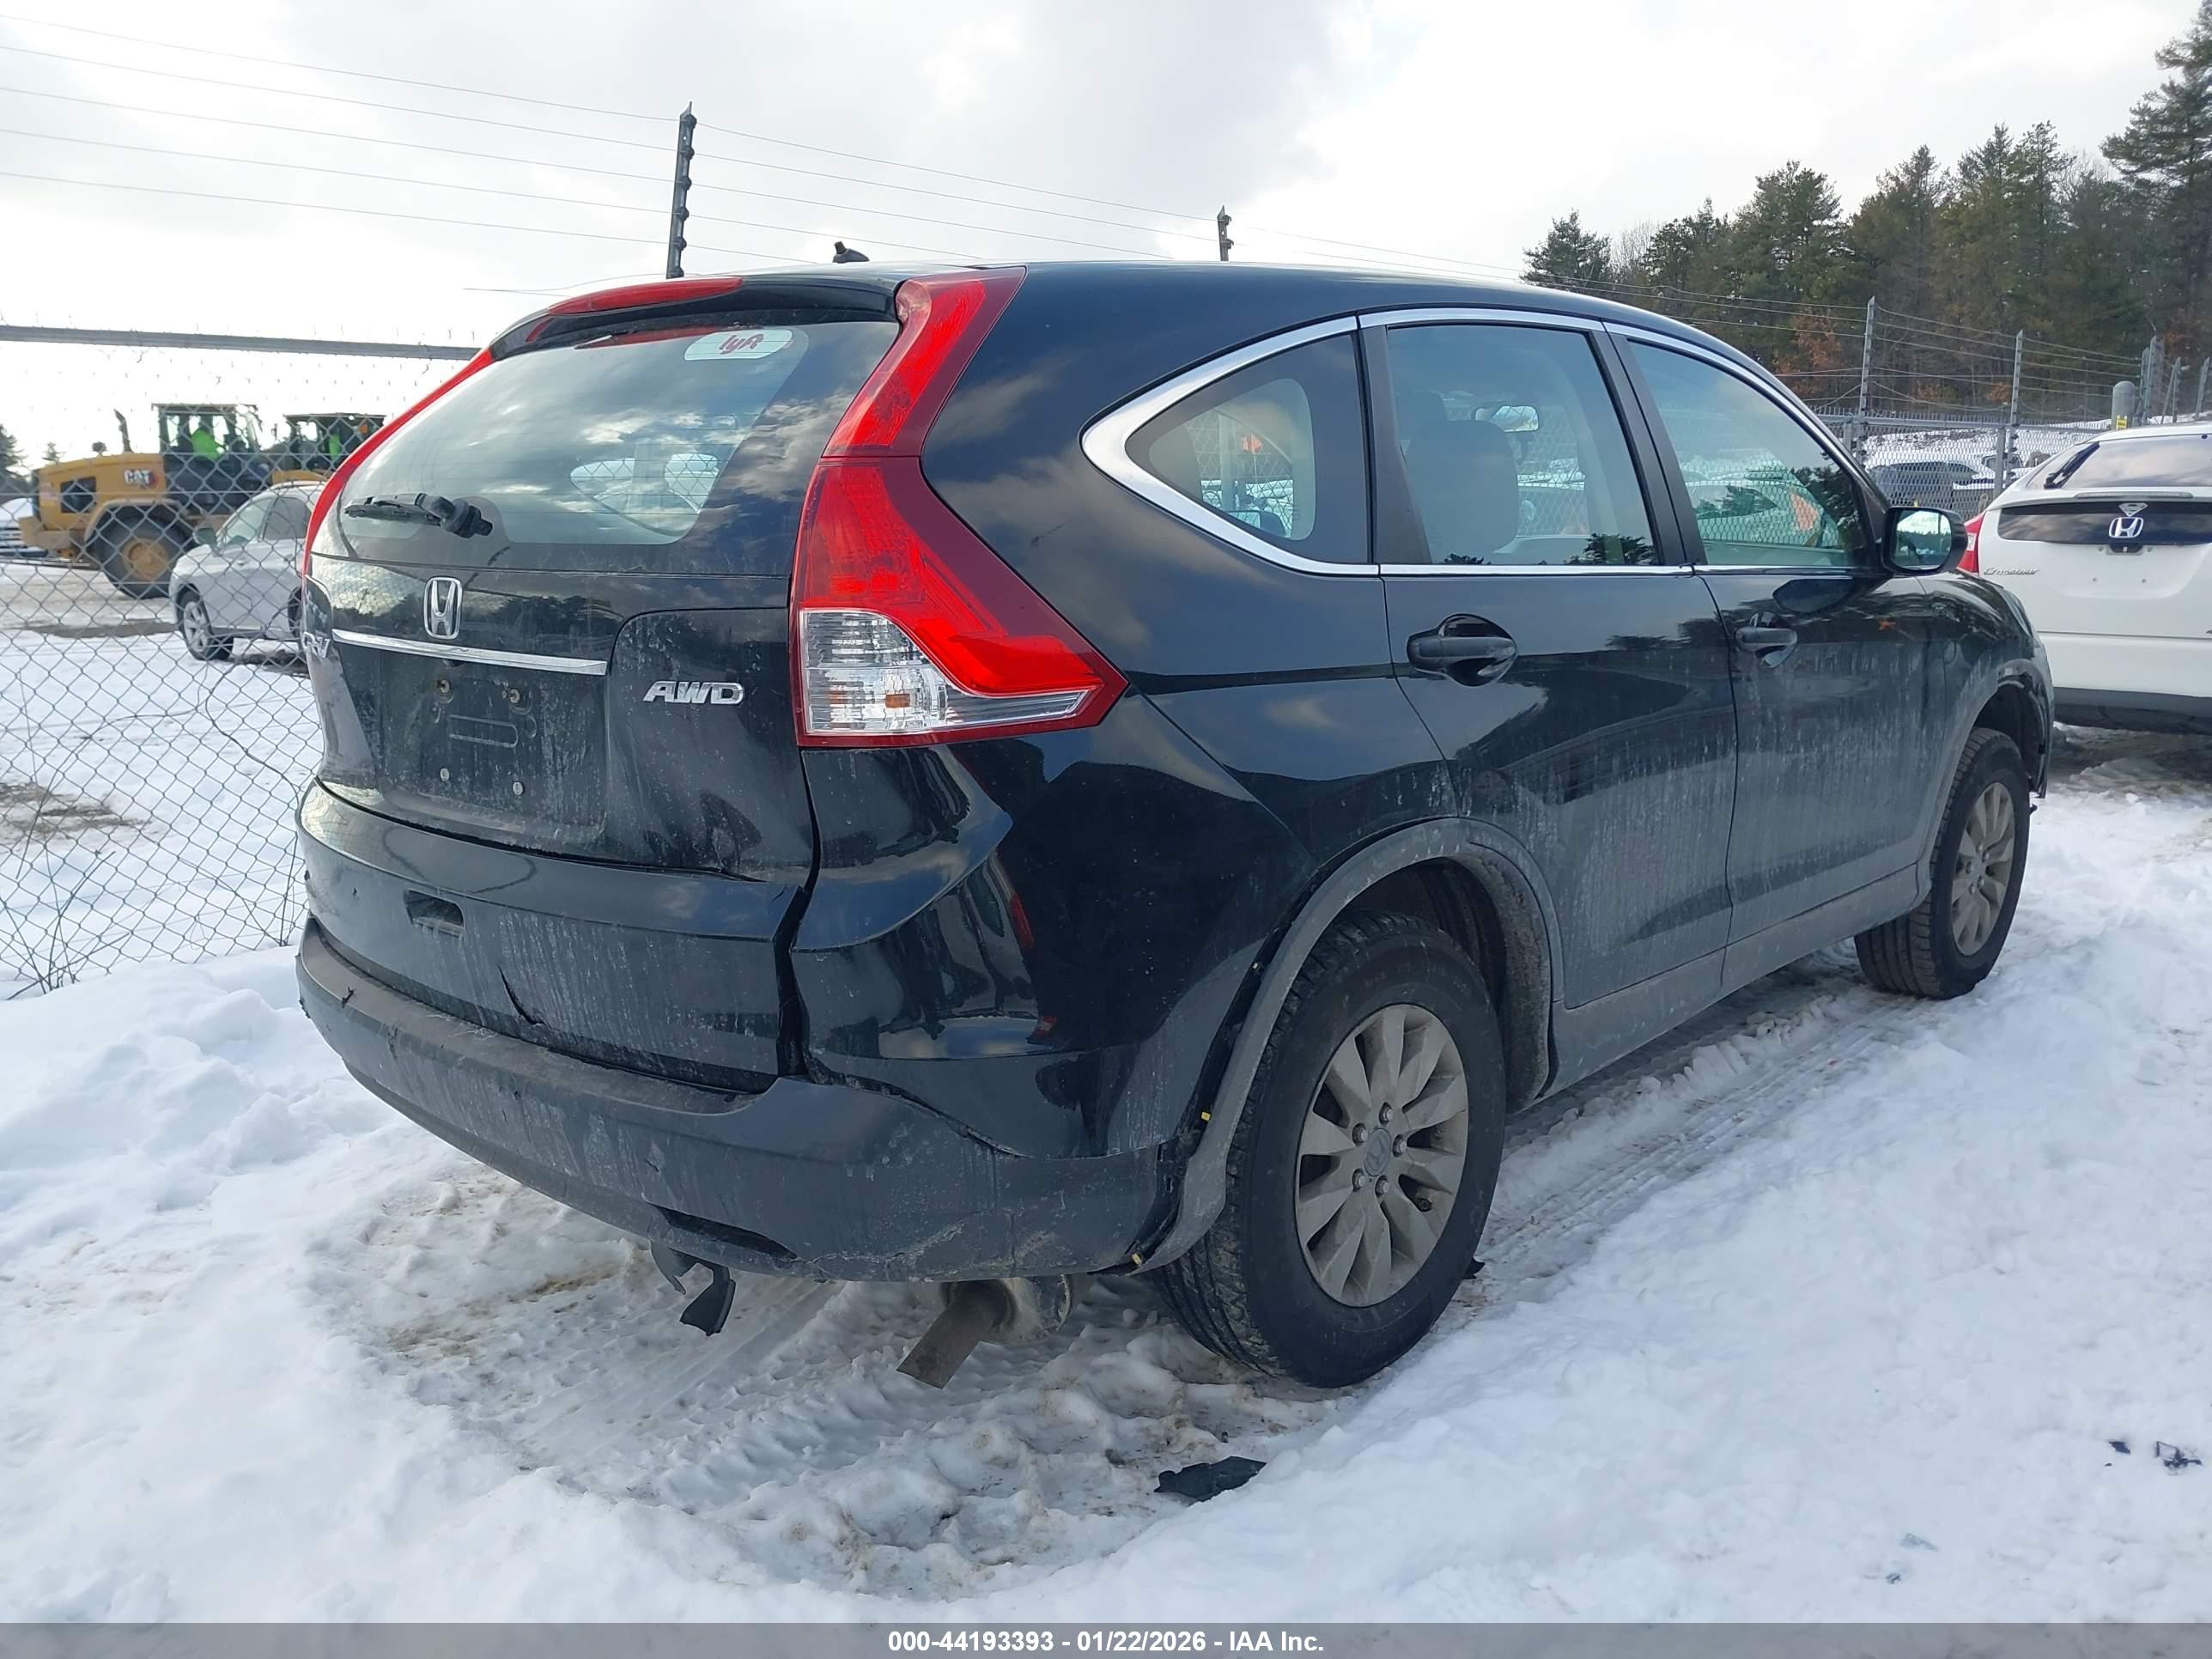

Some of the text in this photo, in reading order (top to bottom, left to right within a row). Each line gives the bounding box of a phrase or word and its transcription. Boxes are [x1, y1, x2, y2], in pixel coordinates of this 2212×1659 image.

[719, 333, 764, 355] lyft
[124, 469, 152, 486] CAT
[642, 680, 744, 704] AWD
